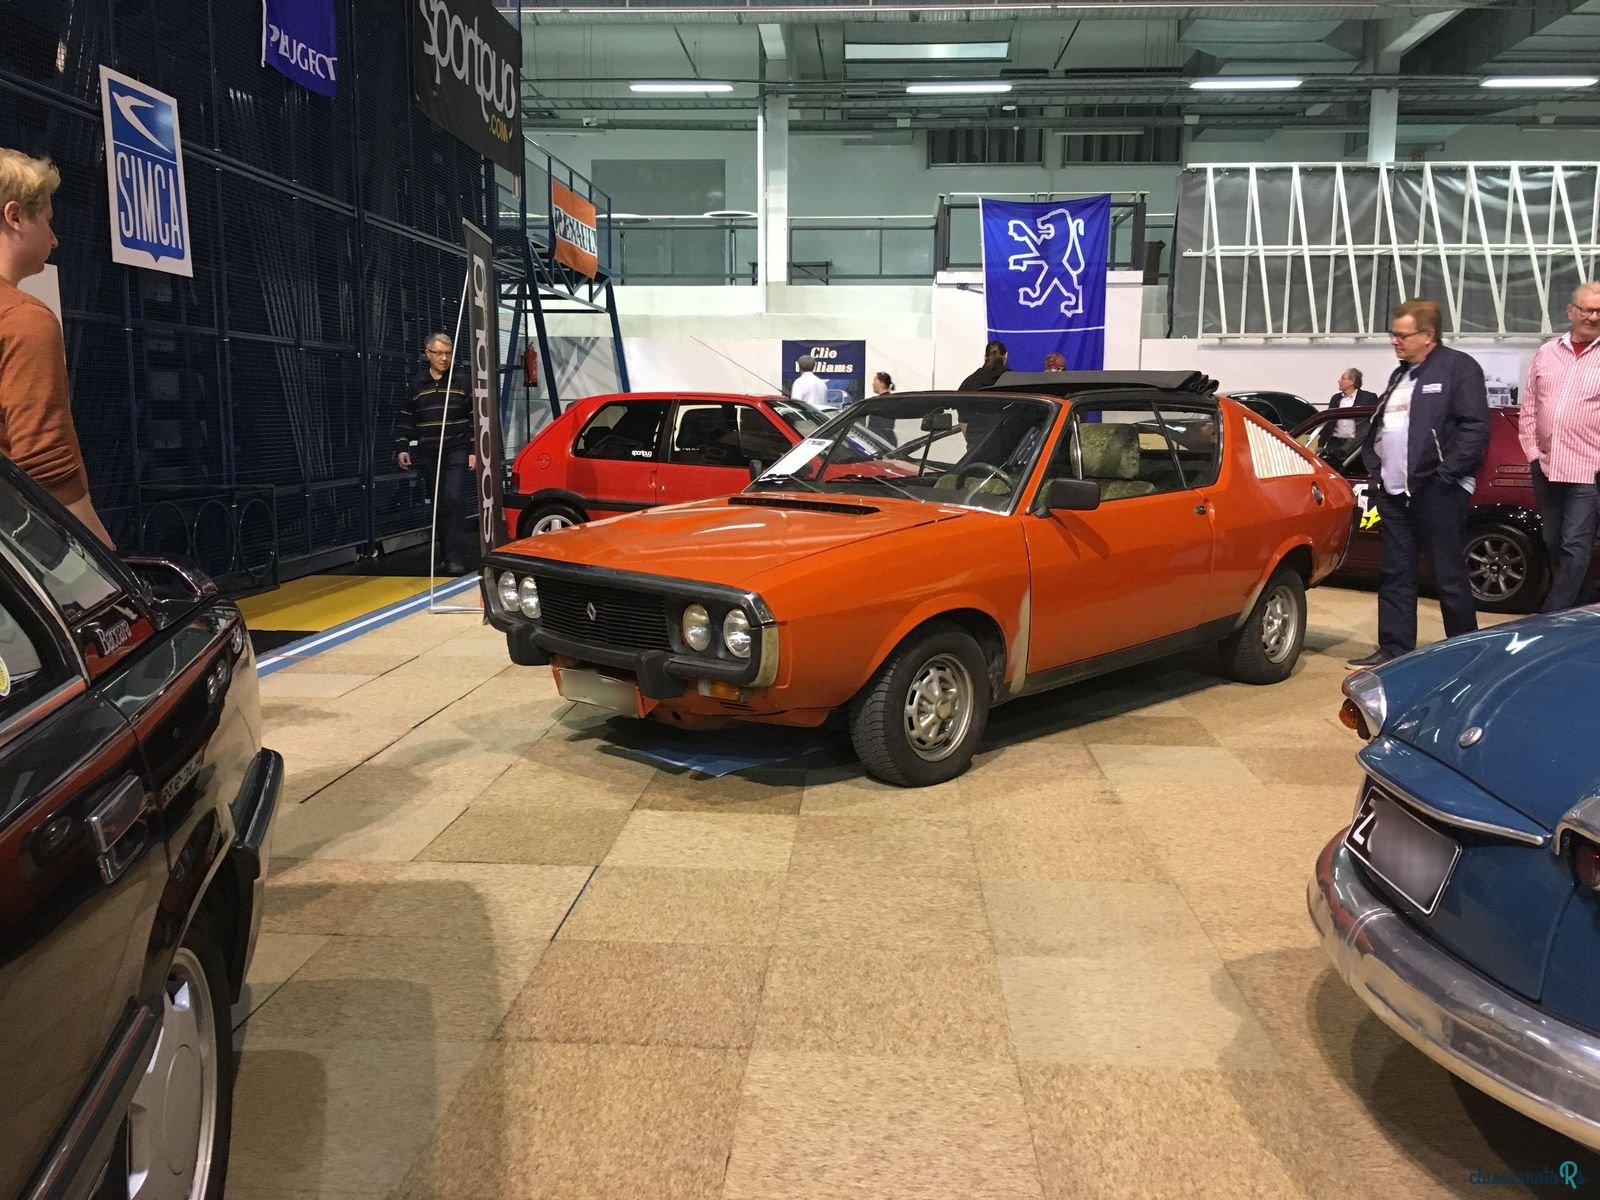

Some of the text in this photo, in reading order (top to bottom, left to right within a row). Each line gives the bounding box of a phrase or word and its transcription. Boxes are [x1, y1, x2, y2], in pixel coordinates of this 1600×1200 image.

[116, 151, 183, 250] SIMCA
[810, 346, 838, 359] Clio
[795, 361, 854, 373] lliams
[95, 619, 133, 656] Baccara
